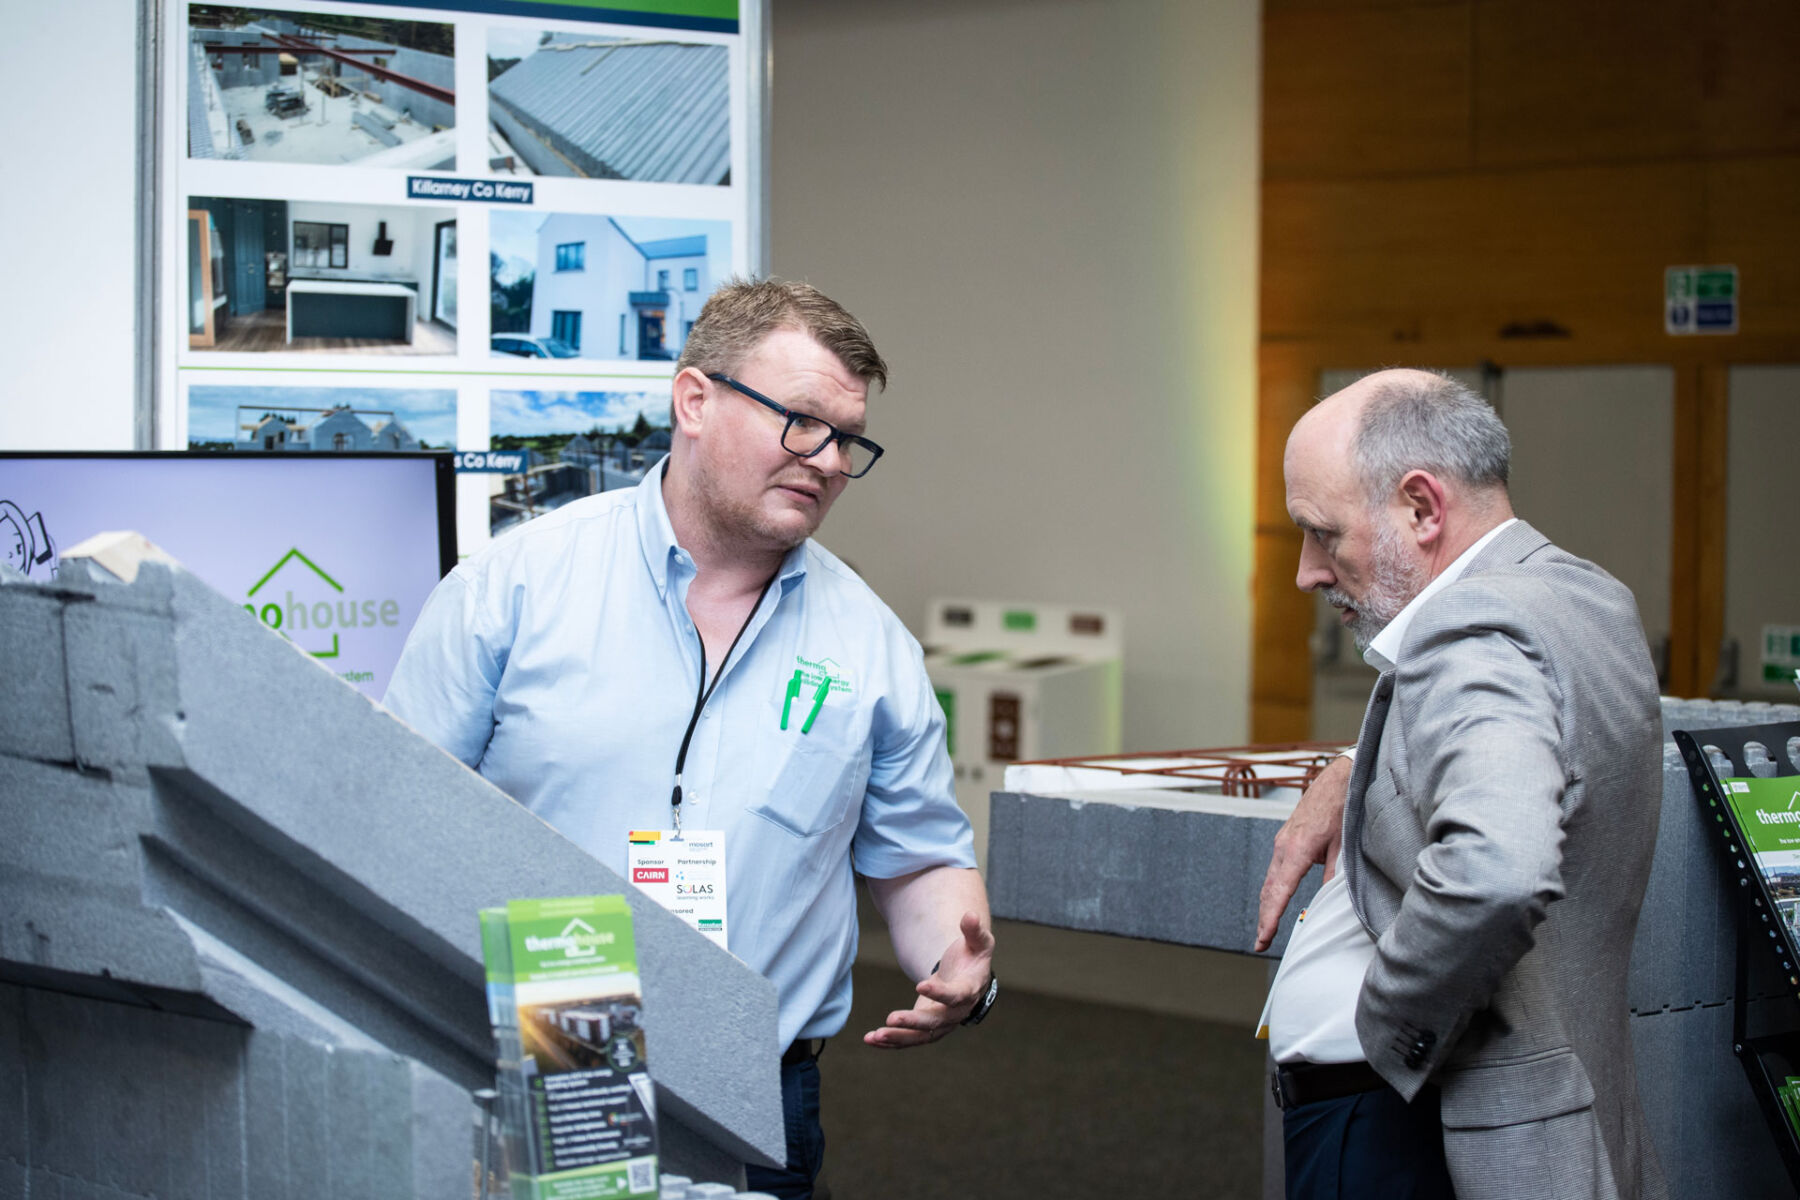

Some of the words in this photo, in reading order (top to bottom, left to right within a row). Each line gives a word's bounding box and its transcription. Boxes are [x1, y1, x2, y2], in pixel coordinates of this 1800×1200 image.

[411, 179, 471, 199] Killarney
[472, 182, 494, 197] Co
[495, 183, 531, 202] Kerry
[463, 453, 485, 468] Co
[486, 453, 522, 472] Kerry
[636, 871, 666, 880] CAIRN
[676, 884, 714, 894] SOLAS
